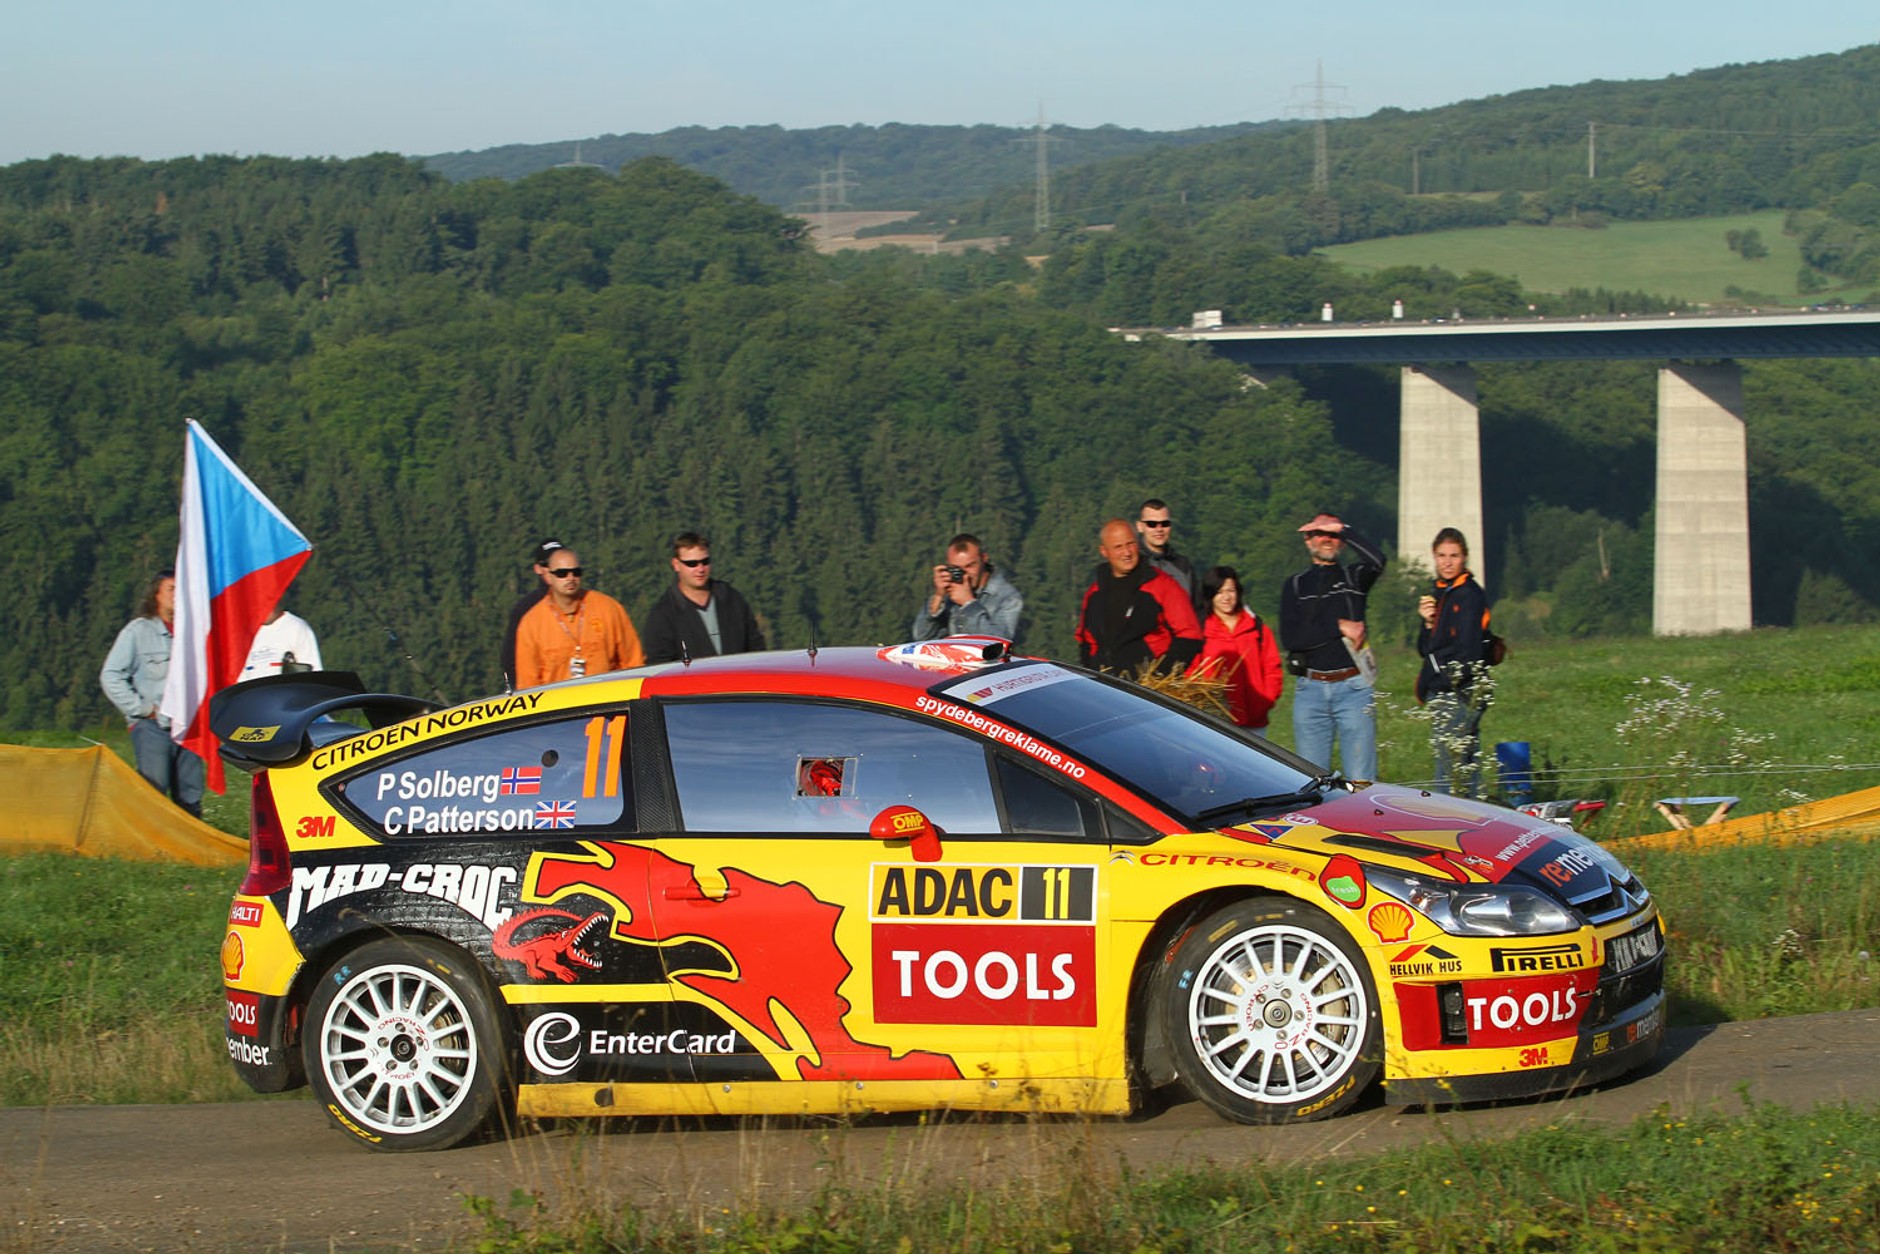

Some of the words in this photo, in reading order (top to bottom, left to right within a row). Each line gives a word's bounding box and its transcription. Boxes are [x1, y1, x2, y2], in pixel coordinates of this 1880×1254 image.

[426, 692, 544, 733] NORWAY
[915, 695, 1086, 780] spydebergreklame.no
[582, 714, 627, 798] 11
[377, 773, 395, 800] P
[398, 770, 500, 803] Solberg
[296, 815, 336, 838] 3M
[384, 809, 403, 836] C
[407, 804, 534, 833] Patterson
[892, 814, 925, 830] OMP
[285, 863, 518, 936] MAD-CROC
[877, 867, 1013, 917] ADAC
[1042, 868, 1071, 920] 11
[1389, 962, 1434, 976] HELLVIK
[1439, 960, 1462, 973] HUS
[1490, 943, 1584, 973] PIRELLI
[892, 950, 1075, 1000] TOOLS
[227, 1000, 256, 1024] OOLS
[1467, 987, 1577, 1031] TOOLS
[589, 1029, 736, 1055] EnterCard
[1519, 1047, 1548, 1067] 3M
